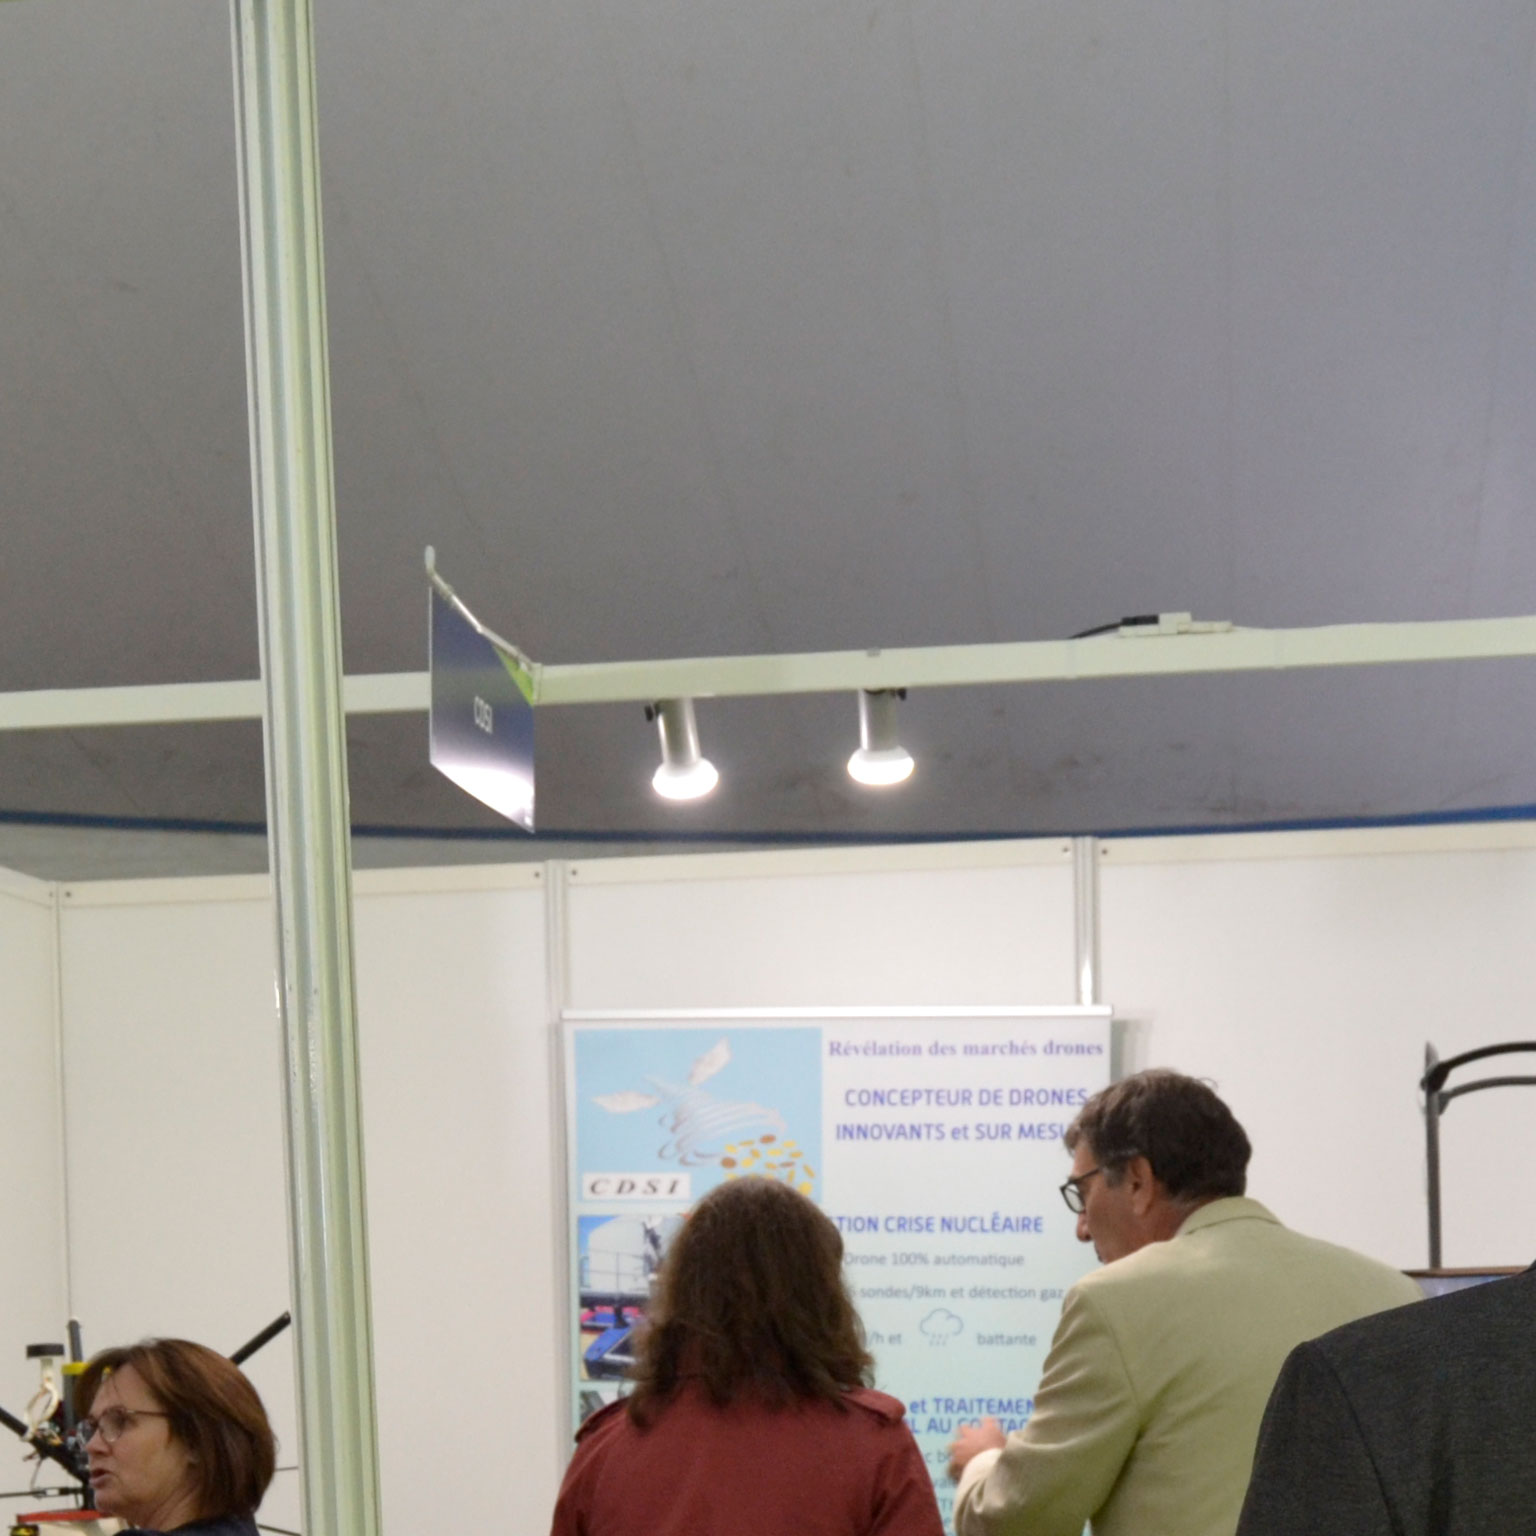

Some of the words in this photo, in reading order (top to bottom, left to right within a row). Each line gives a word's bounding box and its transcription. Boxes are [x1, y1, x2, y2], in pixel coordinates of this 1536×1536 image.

[829, 1040, 922, 1057] Révélation
[928, 1040, 957, 1057] des
[964, 1040, 1037, 1057] marchés
[1043, 1039, 1104, 1057] drones
[845, 1088, 973, 1107] CONCEPTEUR
[978, 1088, 1004, 1106] DE
[1009, 1087, 1088, 1107] DRONES
[836, 1123, 945, 1141] INNOVANTS
[951, 1124, 970, 1141] et
[975, 1123, 1012, 1141] SUR
[1017, 1123, 1065, 1141] MESU
[590, 1178, 679, 1195] CDSI
[832, 1216, 879, 1233] TION
[884, 1216, 935, 1233] CRISE
[892, 1252, 930, 1266] 100%
[933, 1252, 1025, 1268] automatique
[950, 1286, 965, 1299] et
[888, 1333, 902, 1346] et
[977, 1332, 1037, 1347] battante
[910, 1399, 927, 1414] et
[934, 1397, 1035, 1415] TRAITEMEN
[927, 1418, 952, 1434] AU
